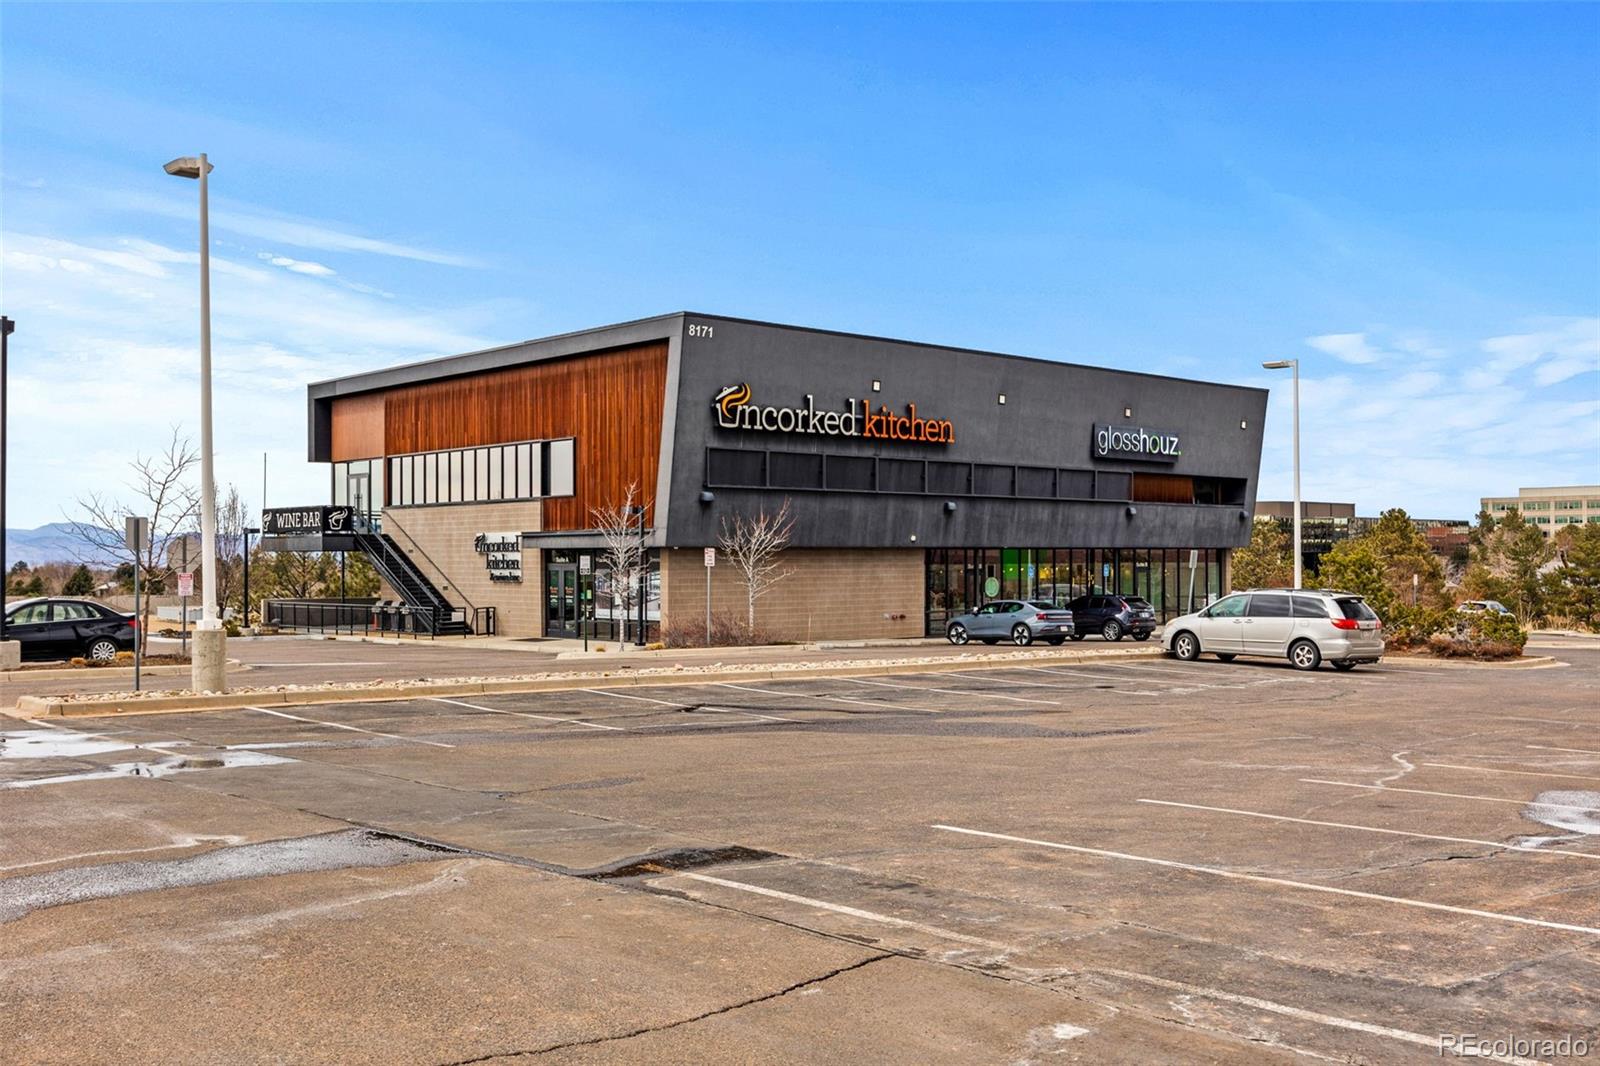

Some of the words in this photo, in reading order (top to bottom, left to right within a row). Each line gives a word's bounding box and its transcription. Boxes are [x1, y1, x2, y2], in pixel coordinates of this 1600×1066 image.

[688, 325, 713, 338] 8171
[863, 400, 954, 443] kitchen
[276, 512, 301, 528] WINE
[302, 511, 320, 527] BAR
